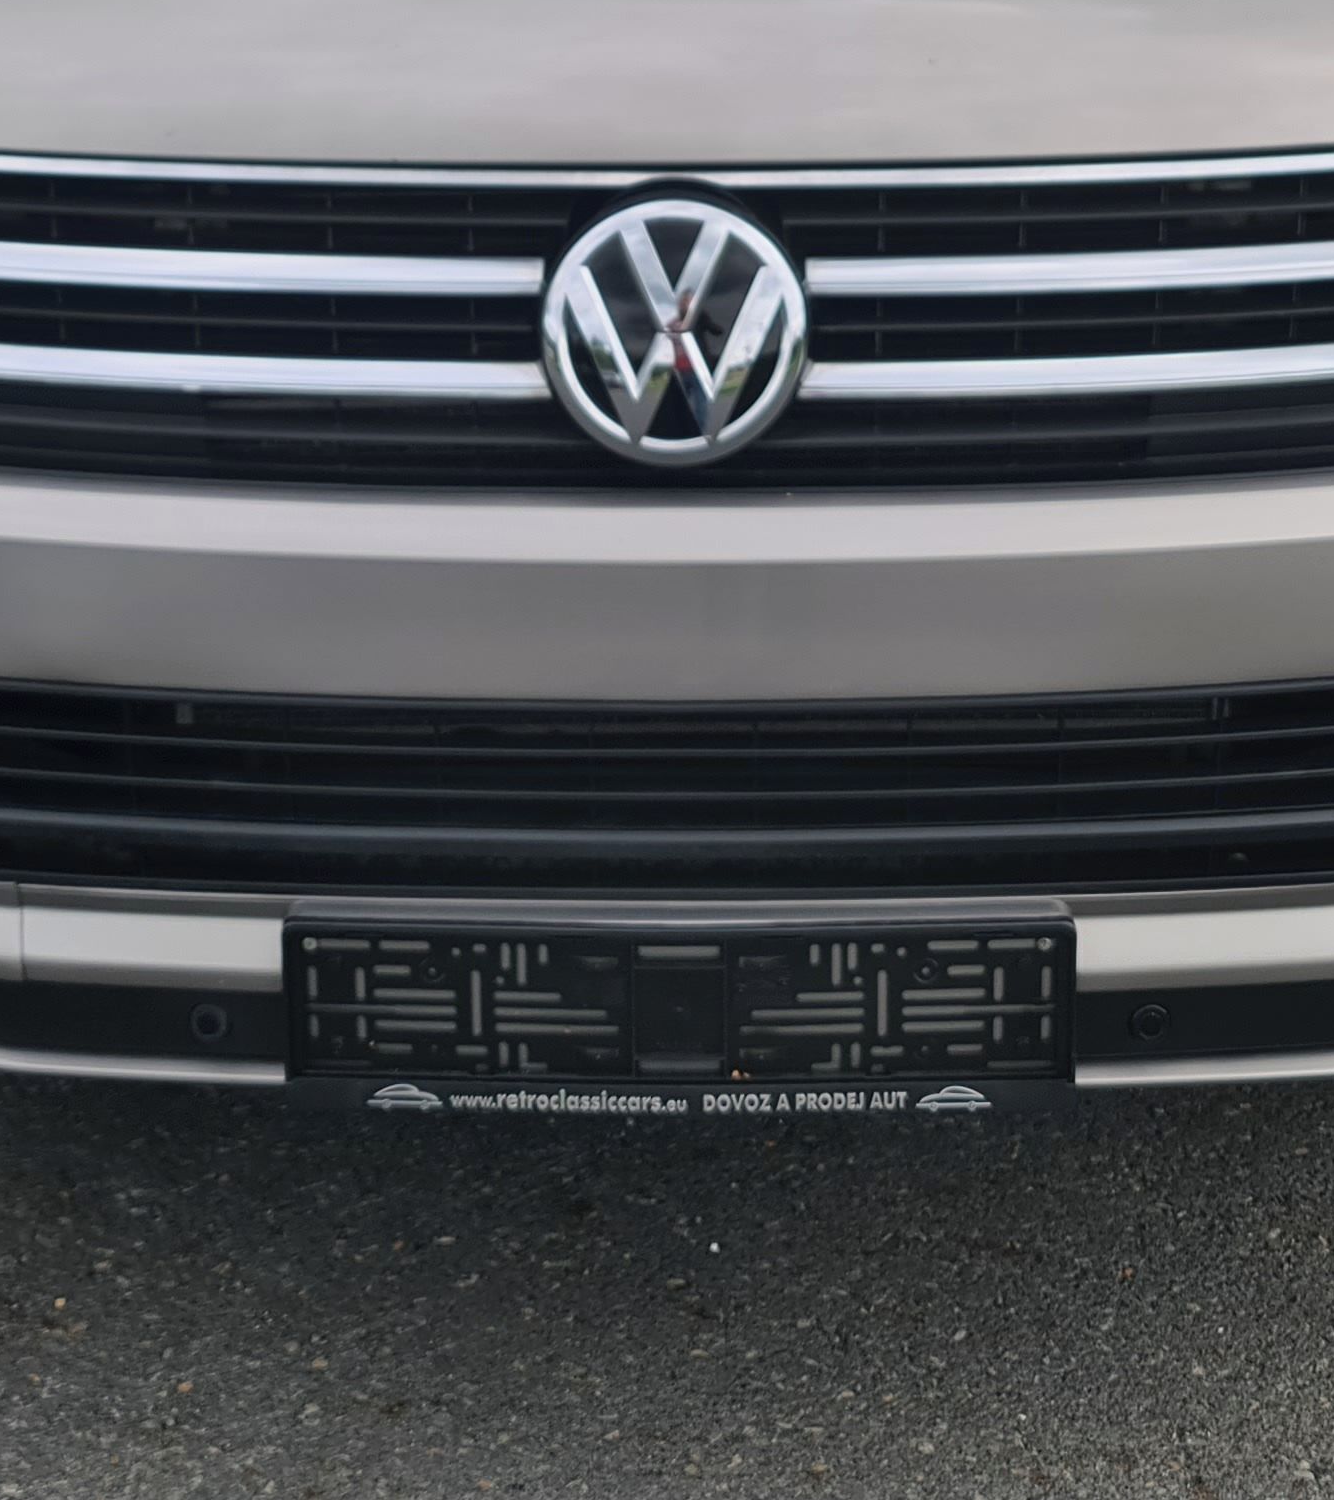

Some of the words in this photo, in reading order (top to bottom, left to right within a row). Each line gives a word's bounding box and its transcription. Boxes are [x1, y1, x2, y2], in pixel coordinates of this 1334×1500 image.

[449, 1088, 688, 1112] www.retroclassiccars.eu
[702, 1093, 772, 1112] DOVOZ
[775, 1093, 792, 1111] A
[794, 1091, 865, 1111] PRODEJ
[869, 1090, 908, 1110] AUT
